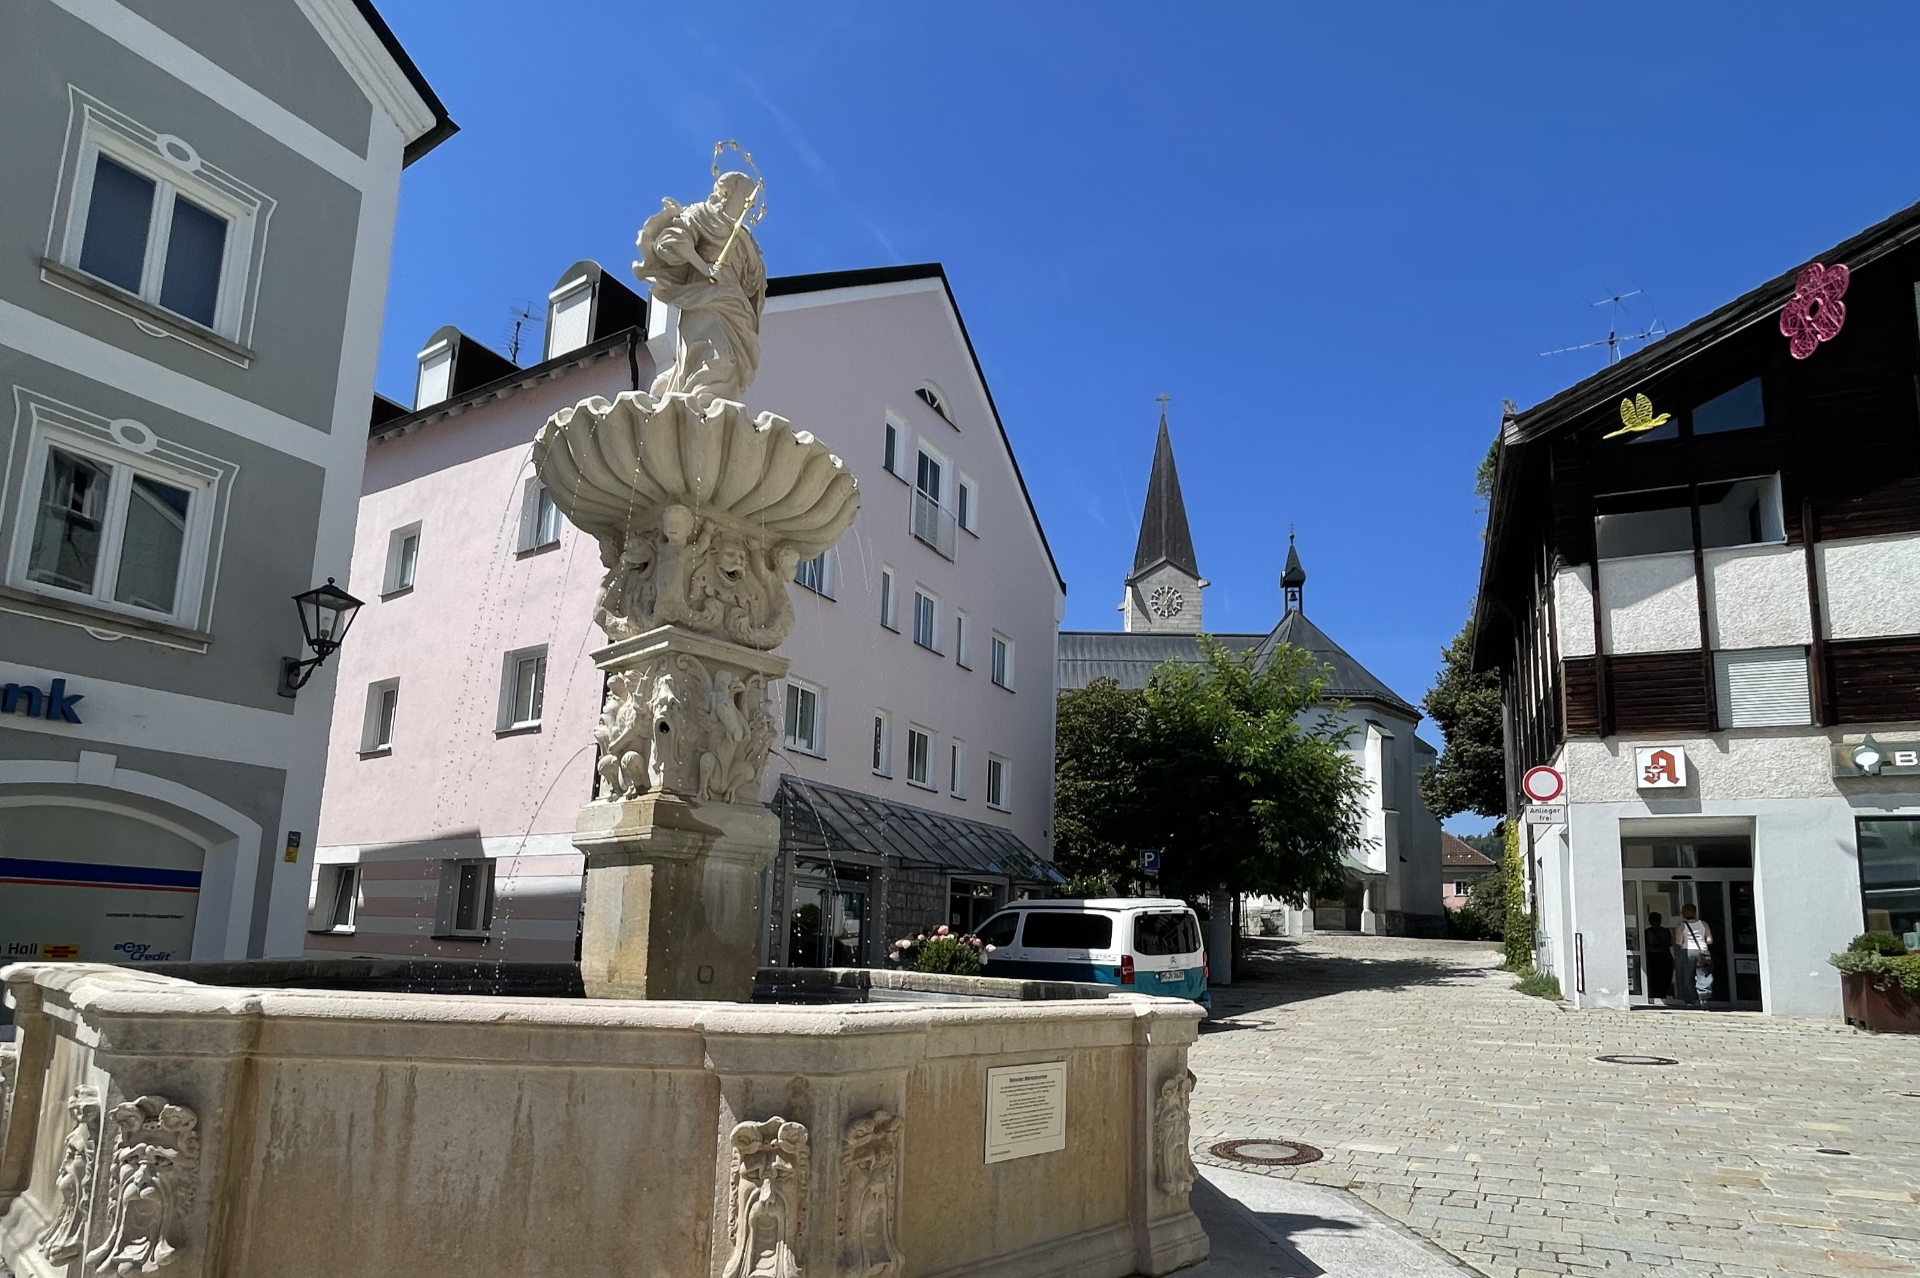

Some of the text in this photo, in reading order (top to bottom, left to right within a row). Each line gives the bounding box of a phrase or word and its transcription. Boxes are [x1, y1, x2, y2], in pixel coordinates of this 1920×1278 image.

[1530, 807, 1561, 815] Anlieger
[1144, 852, 1154, 867] P
[8, 942, 38, 955] Hall
[130, 951, 171, 961] Credit
